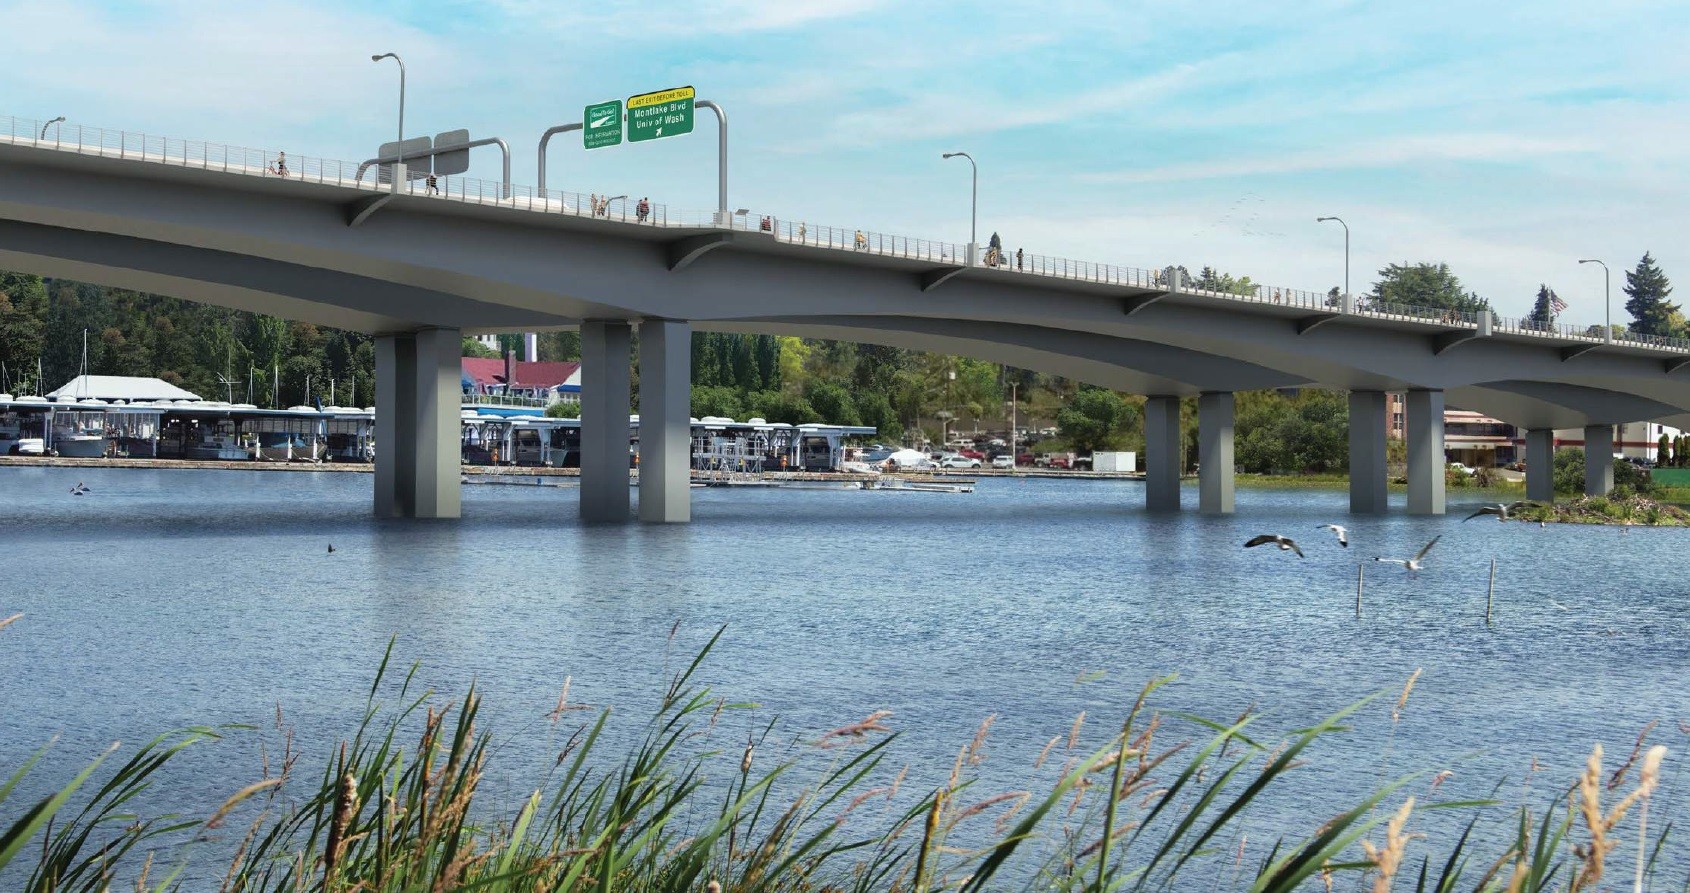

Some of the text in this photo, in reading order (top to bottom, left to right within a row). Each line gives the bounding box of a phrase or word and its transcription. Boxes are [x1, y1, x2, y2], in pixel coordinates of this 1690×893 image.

[632, 90, 689, 106] LAST EXIT BEFORE TOLL
[634, 101, 686, 118] Montlake Blvd
[636, 113, 685, 129] Univ of Wash
